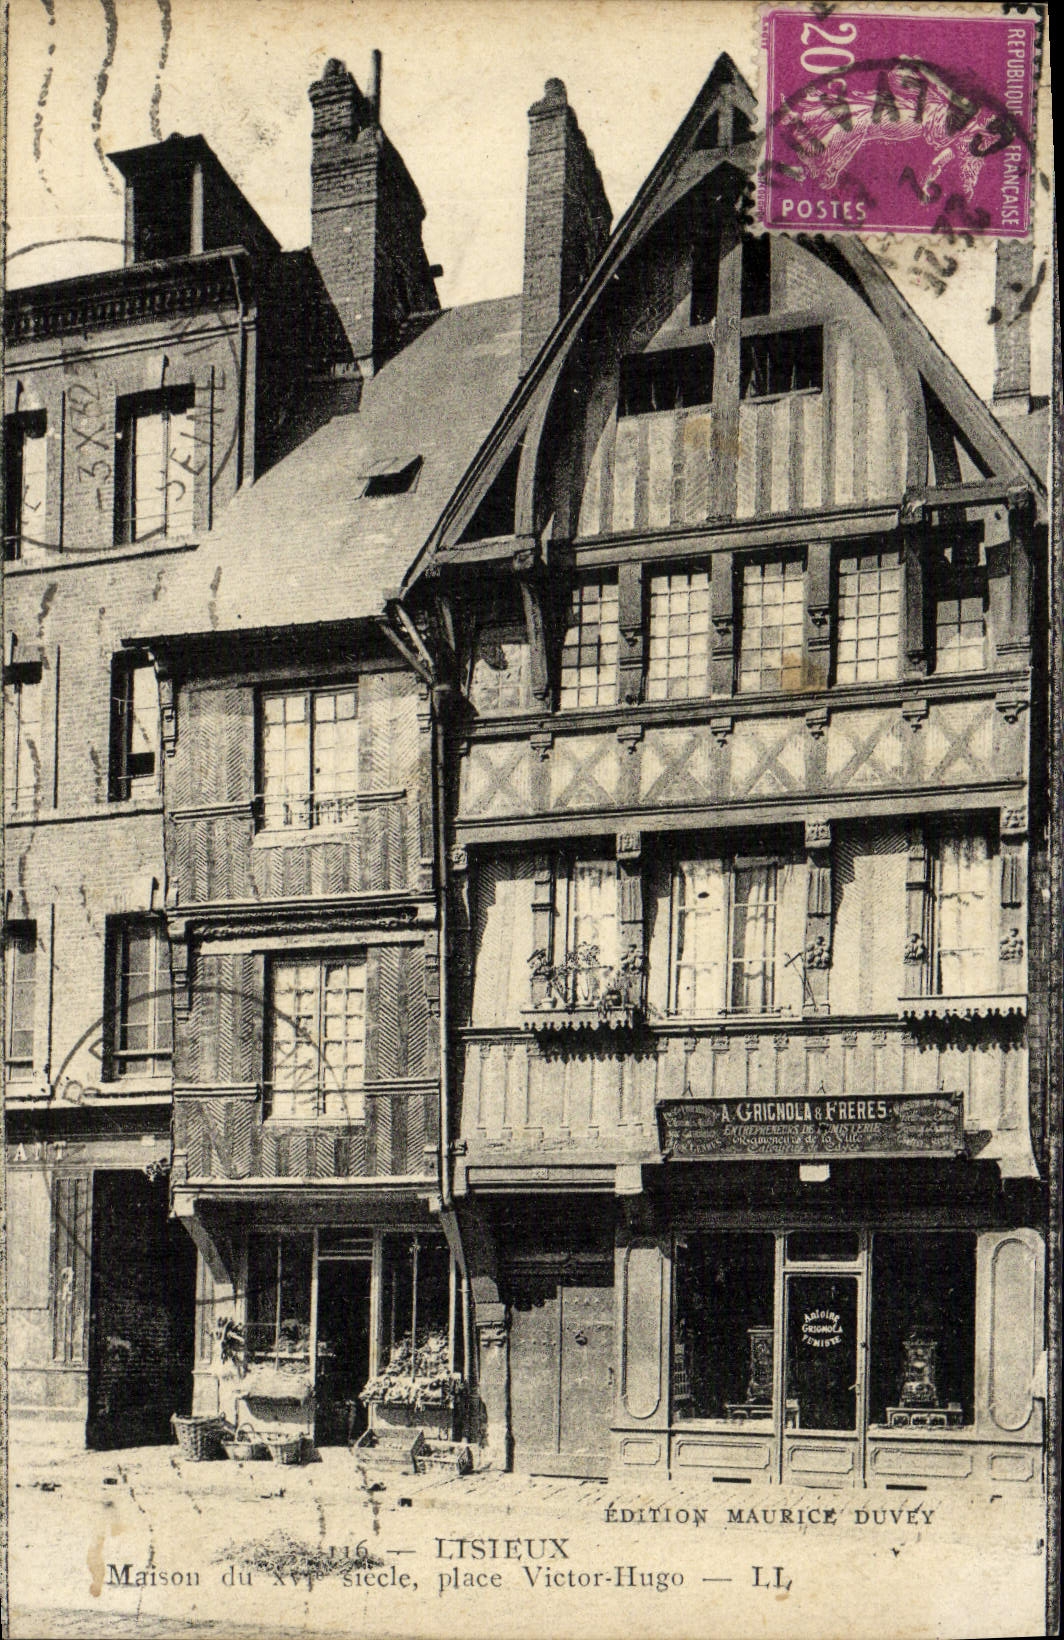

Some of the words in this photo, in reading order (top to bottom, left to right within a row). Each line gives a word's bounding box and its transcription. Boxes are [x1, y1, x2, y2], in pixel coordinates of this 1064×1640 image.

[799, 22, 858, 75] 20
[999, 144, 1023, 226] FRANÇAISE
[781, 199, 866, 221] POSTES
[736, 1101, 812, 1122] GRIGNOLA
[814, 1106, 823, 1121] &
[723, 1124, 799, 1136] ENTREPRENEURS
[801, 1323, 843, 1333] GRIGNOLA
